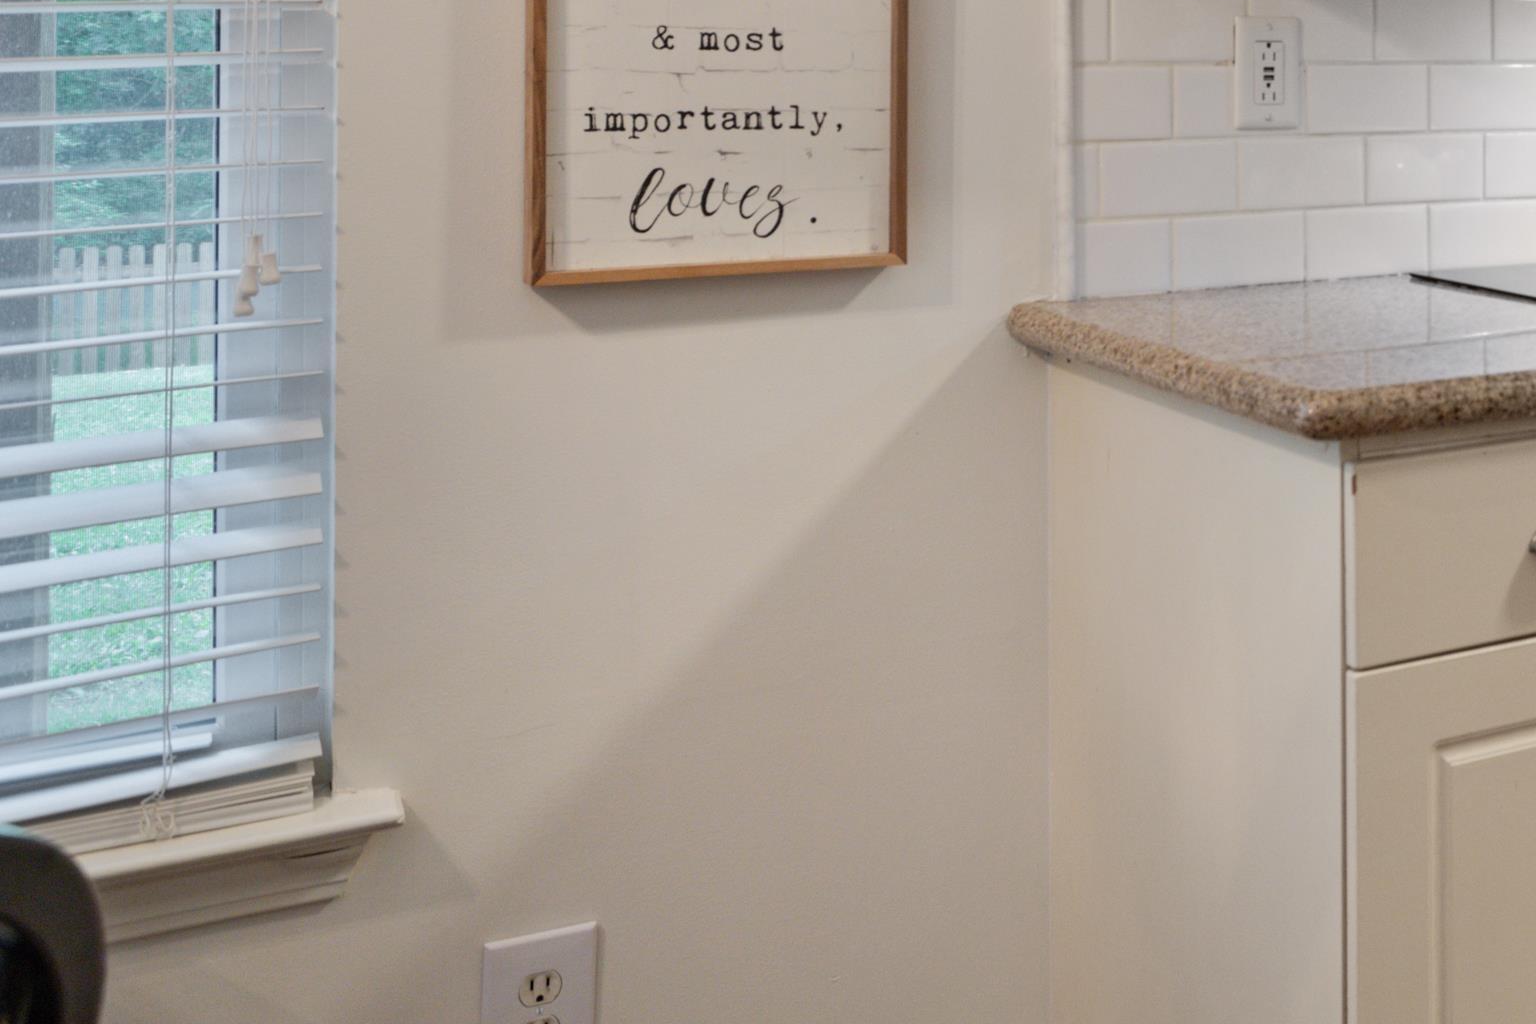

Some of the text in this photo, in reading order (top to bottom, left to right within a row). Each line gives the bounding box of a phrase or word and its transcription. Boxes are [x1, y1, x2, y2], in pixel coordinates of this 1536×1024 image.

[651, 24, 785, 53] & most
[583, 104, 843, 140] importantly,
